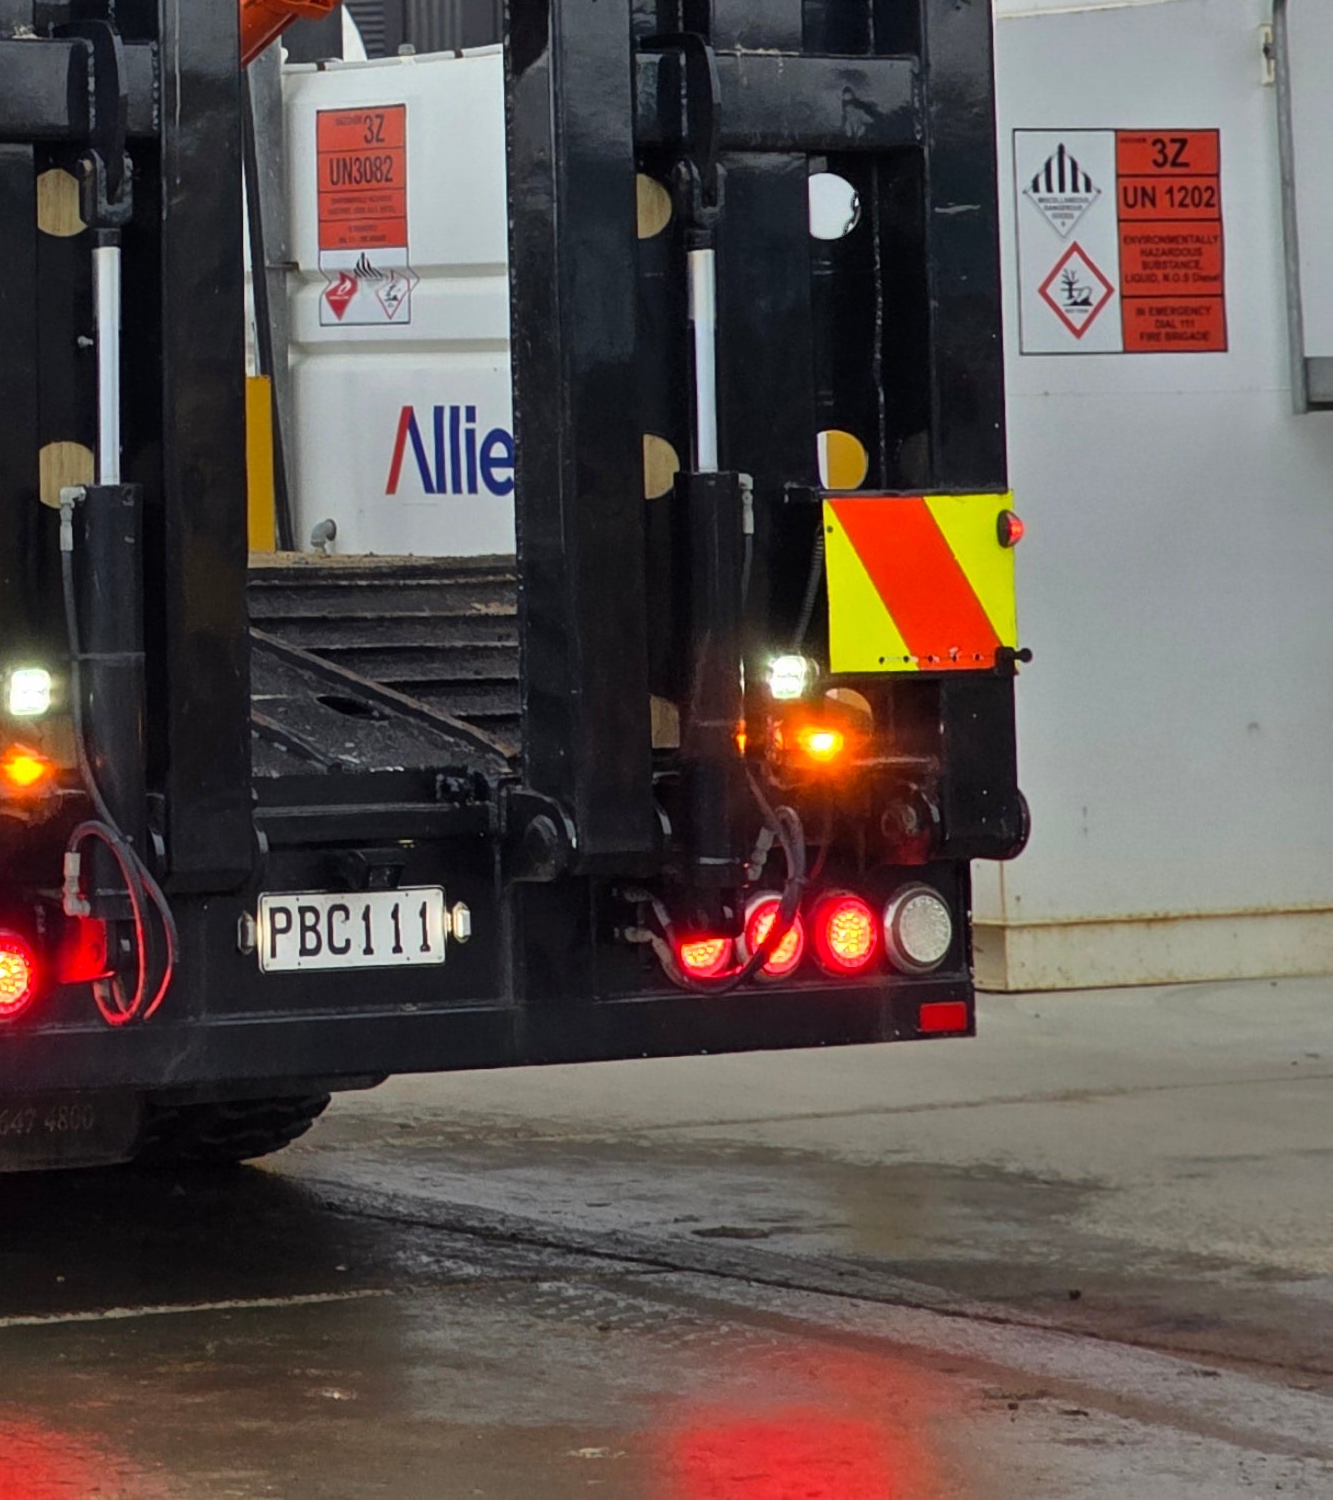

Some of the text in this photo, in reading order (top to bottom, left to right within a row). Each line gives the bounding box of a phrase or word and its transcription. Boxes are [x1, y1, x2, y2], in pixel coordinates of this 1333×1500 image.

[363, 113, 385, 144] 3Z
[1151, 137, 1191, 169] 3Z
[329, 154, 394, 186] UN3082
[1122, 185, 1217, 209] UN 1202
[269, 900, 431, 959] PBC111
